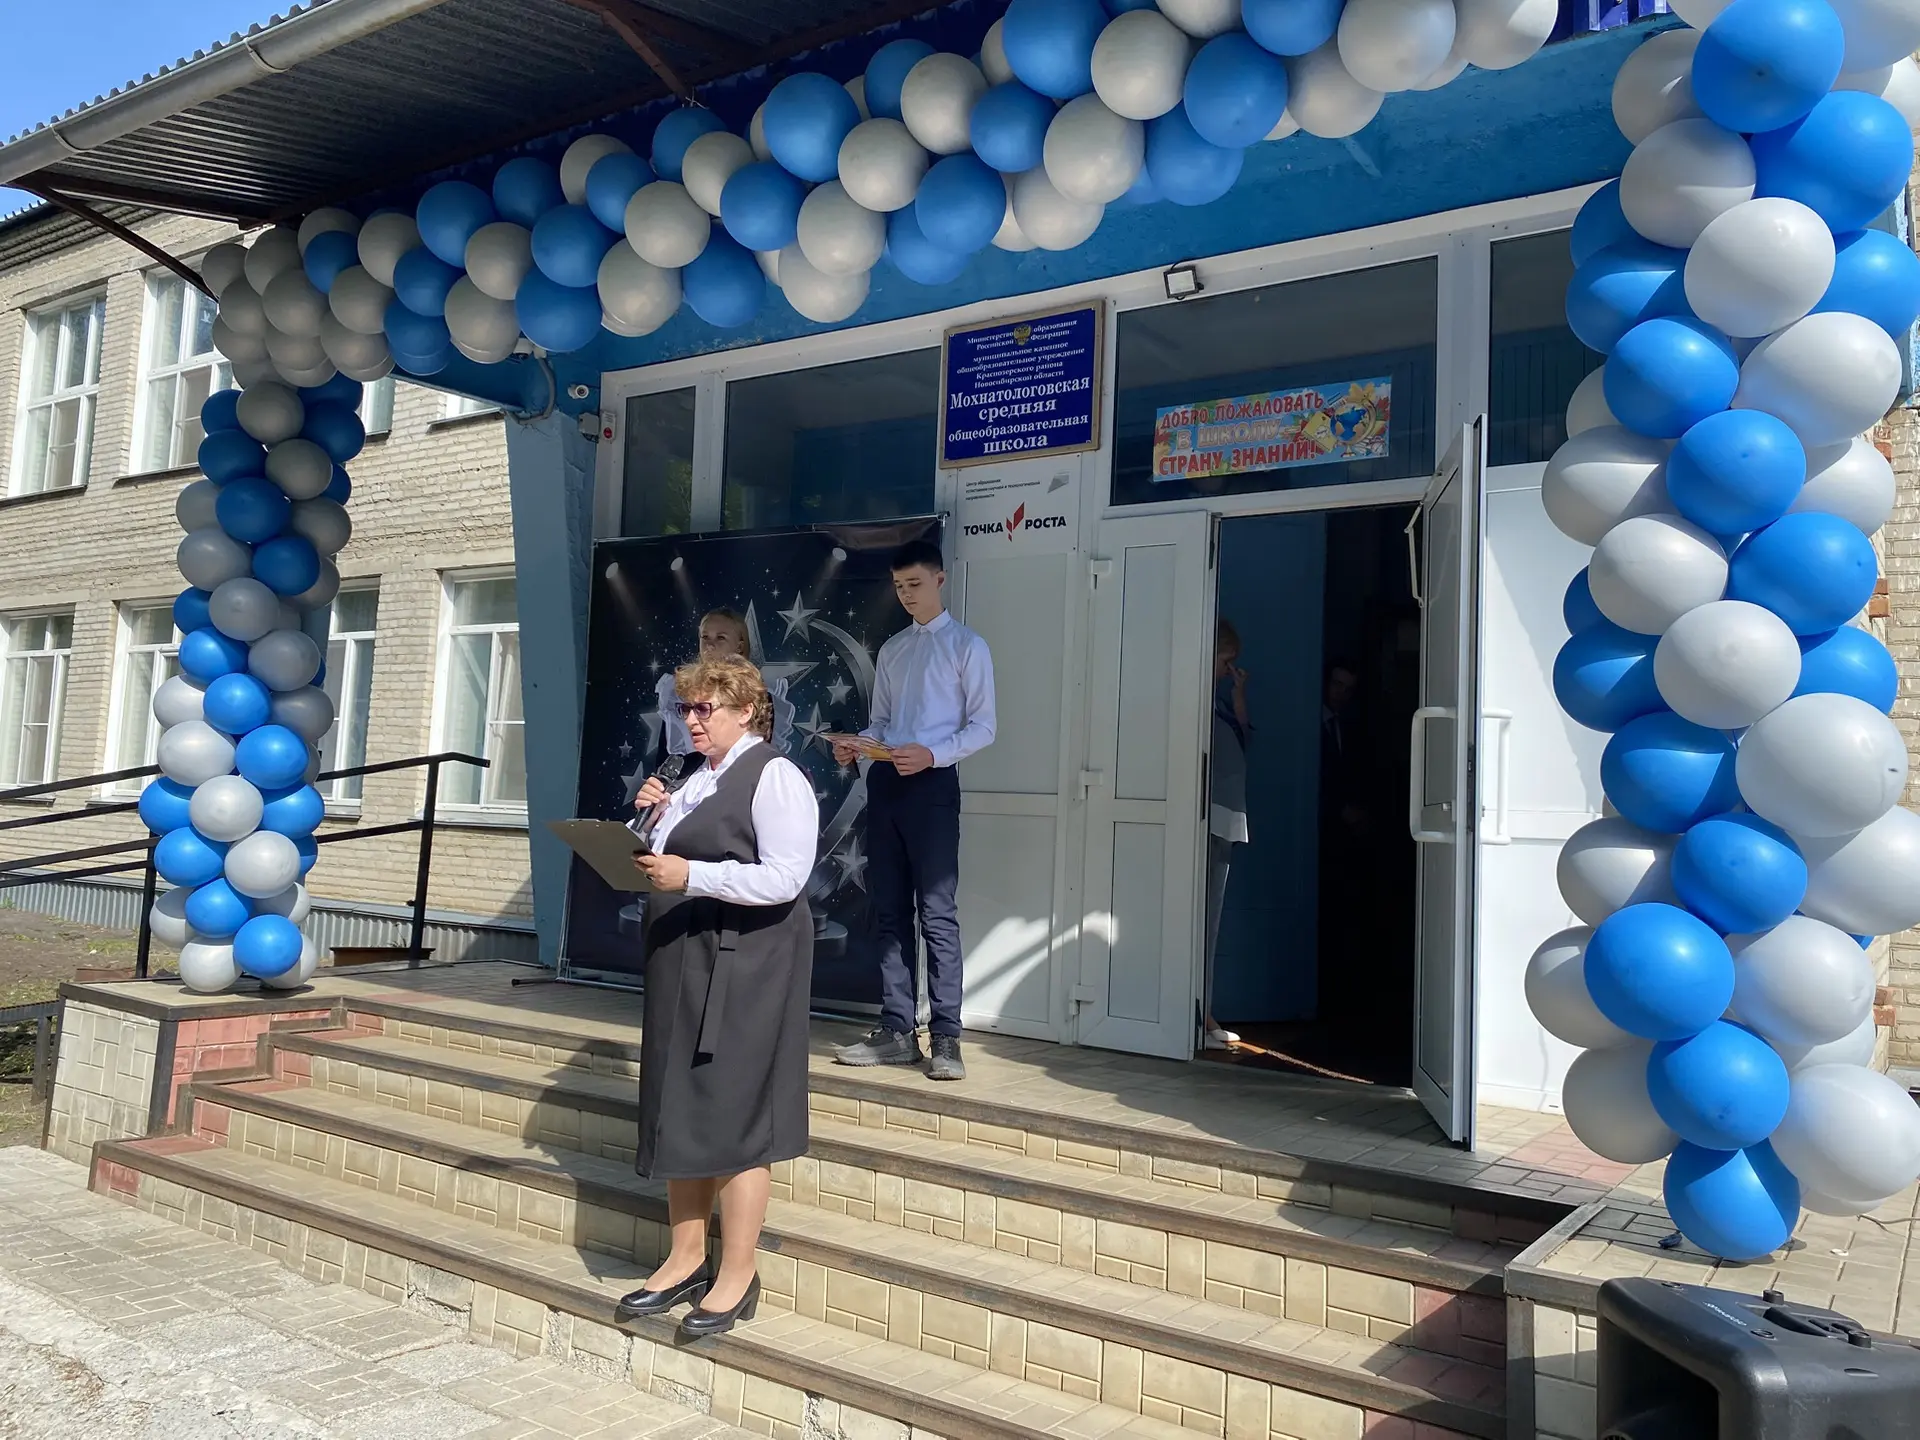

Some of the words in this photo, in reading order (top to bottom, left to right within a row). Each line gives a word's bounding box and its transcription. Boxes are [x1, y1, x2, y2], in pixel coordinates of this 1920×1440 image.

[967, 331, 1014, 345] Министерство
[1033, 319, 1078, 333] образования
[976, 338, 1014, 351] Российской
[1030, 329, 1070, 341] Федерации
[956, 356, 1037, 374] общеобразовательное
[1038, 347, 1085, 363] учреждение
[973, 347, 1032, 363] муниципальное
[1034, 341, 1069, 353] казенное
[974, 374, 1032, 389] Новосибирской
[1033, 369, 1064, 381] области
[976, 365, 1034, 380] Краснозерского
[1035, 360, 1063, 373] района
[950, 376, 1090, 410] Мохнатологовская
[978, 399, 1056, 422] средняя
[1160, 410, 1209, 430] ДОБРО
[1214, 392, 1323, 420] ПОЖАЛОВАТЬ
[948, 414, 1089, 442] общеобразовательная
[1176, 429, 1192, 451] В
[1197, 418, 1281, 448] ШКОЛУ
[983, 434, 1048, 454] школа
[1159, 452, 1223, 476] СТРАНУ
[1231, 440, 1316, 468] ЗНАНИЙ!
[964, 522, 1004, 536] ТОЧКА
[1025, 516, 1066, 530] РОСТА
